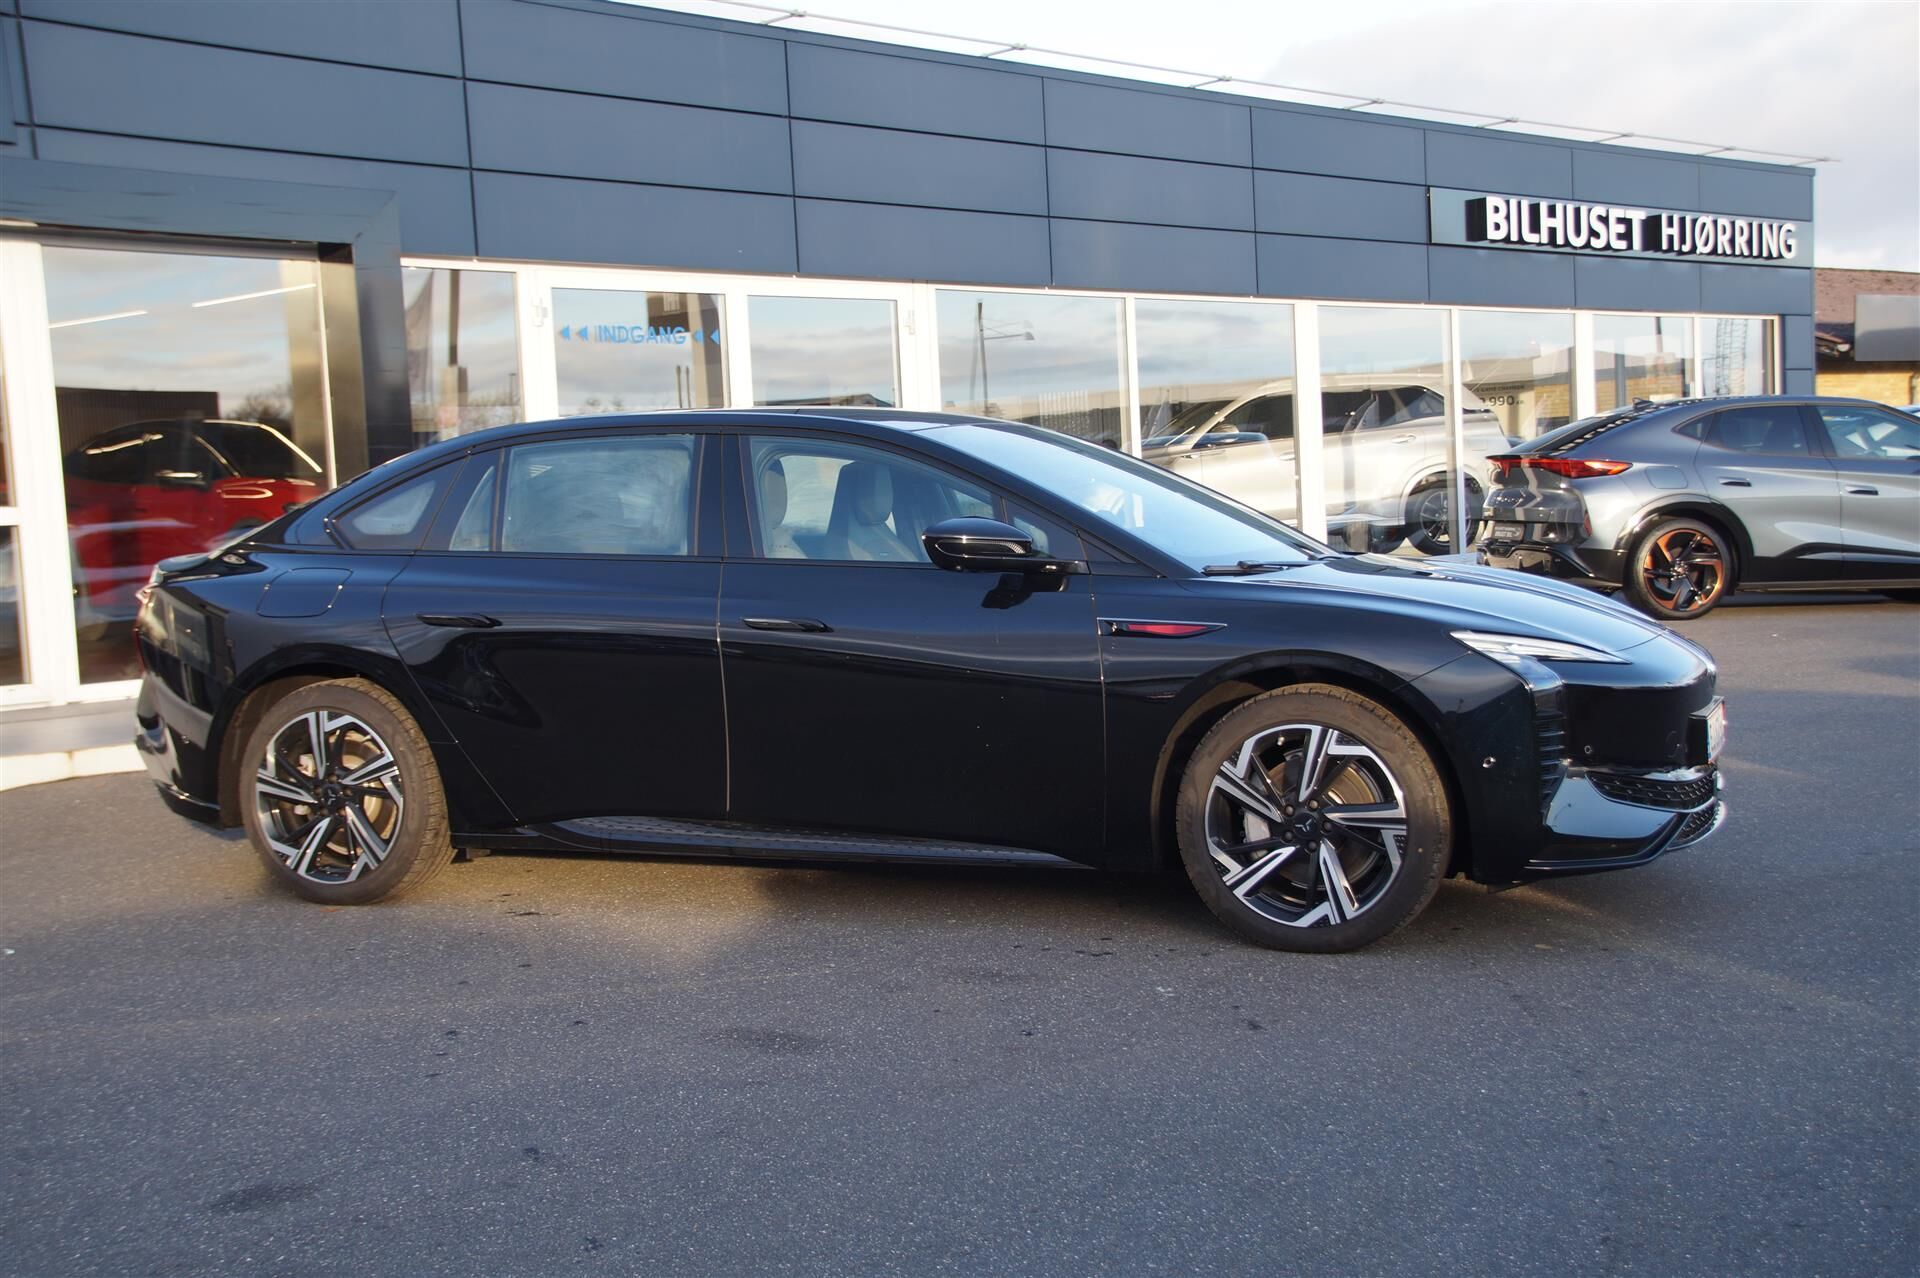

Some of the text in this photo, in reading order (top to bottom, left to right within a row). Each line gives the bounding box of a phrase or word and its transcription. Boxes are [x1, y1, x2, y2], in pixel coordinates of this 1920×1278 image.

[1486, 196, 1797, 260] BILHUSET HJØRRING
[596, 325, 687, 345] INDGANG
